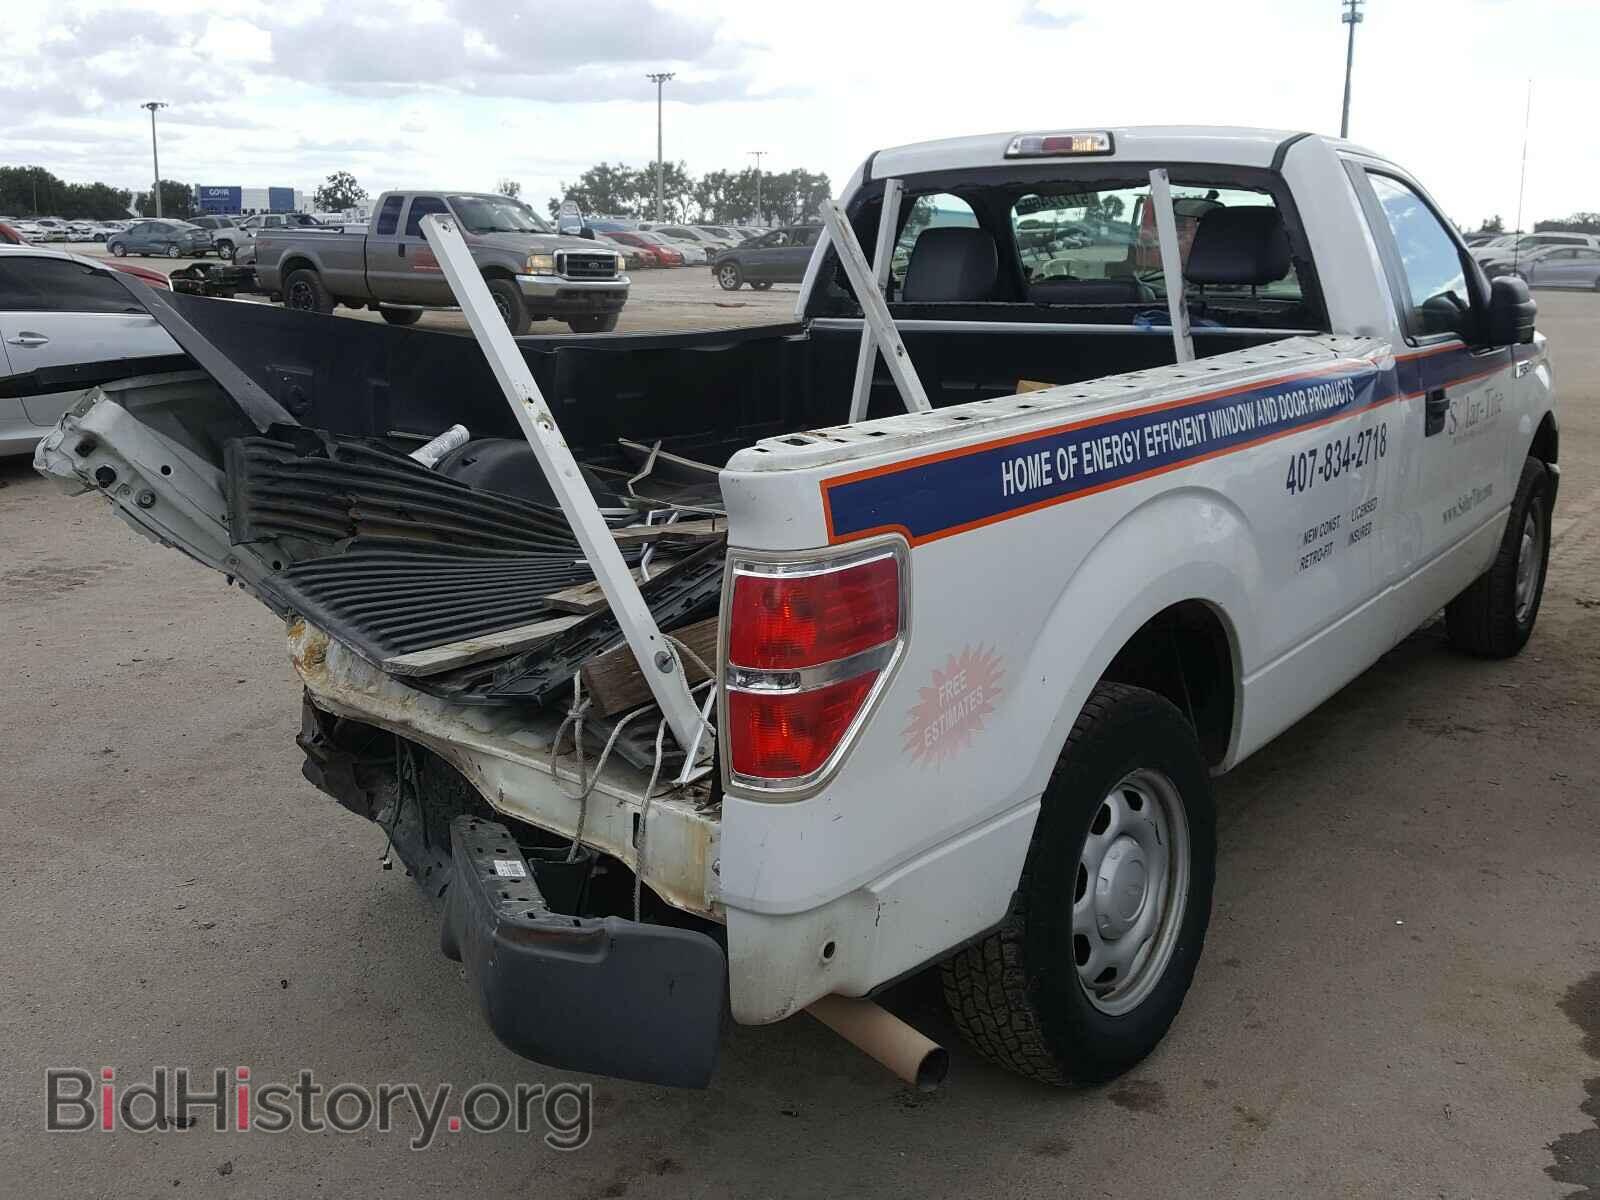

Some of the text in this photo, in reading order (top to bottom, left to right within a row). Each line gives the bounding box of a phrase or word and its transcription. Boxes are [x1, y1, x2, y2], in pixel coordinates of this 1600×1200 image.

[1002, 378, 1355, 496] HOME OF ENERGY EFFICIENT WINDOW AND DOOR PRODUCTS
[1286, 422, 1387, 495] 407-834-2718
[1351, 497, 1378, 522] LICENSED
[1304, 526, 1318, 545] NEW
[1299, 542, 1333, 571] RETRO-FIT
[939, 669, 967, 708] FREE
[924, 686, 983, 746] ESTIMATES
